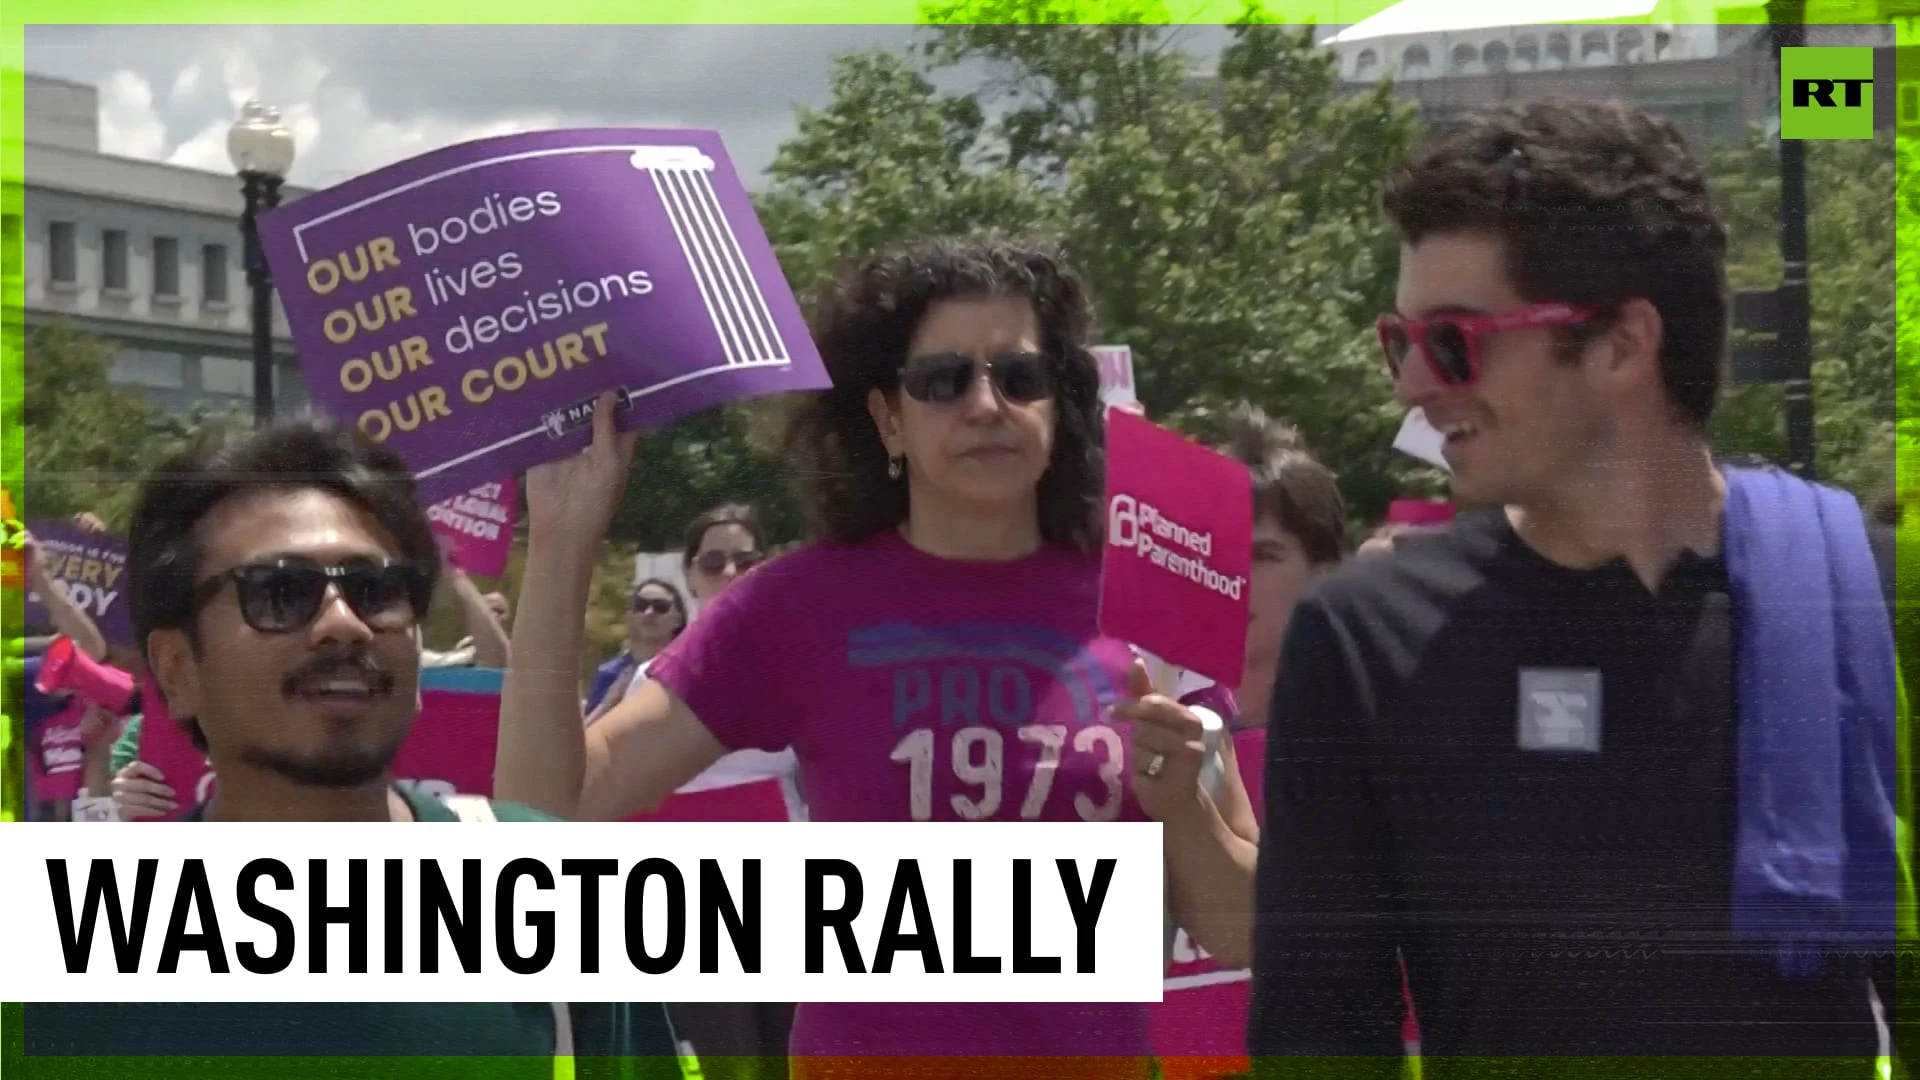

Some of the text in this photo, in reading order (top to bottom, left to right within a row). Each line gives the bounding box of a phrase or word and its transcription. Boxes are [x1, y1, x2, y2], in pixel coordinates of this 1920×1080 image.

[307, 191, 562, 295] OUR bodies
[323, 252, 523, 344] OUR lives
[340, 270, 653, 393] OUR decisions
[357, 386, 453, 443] OUR
[461, 322, 609, 404] COURT
[426, 504, 501, 541] ORTION
[1137, 531, 1241, 600] Parenthood
[1139, 502, 1212, 557] Planned
[893, 664, 1033, 728] PRO
[890, 723, 1124, 822] 1973
